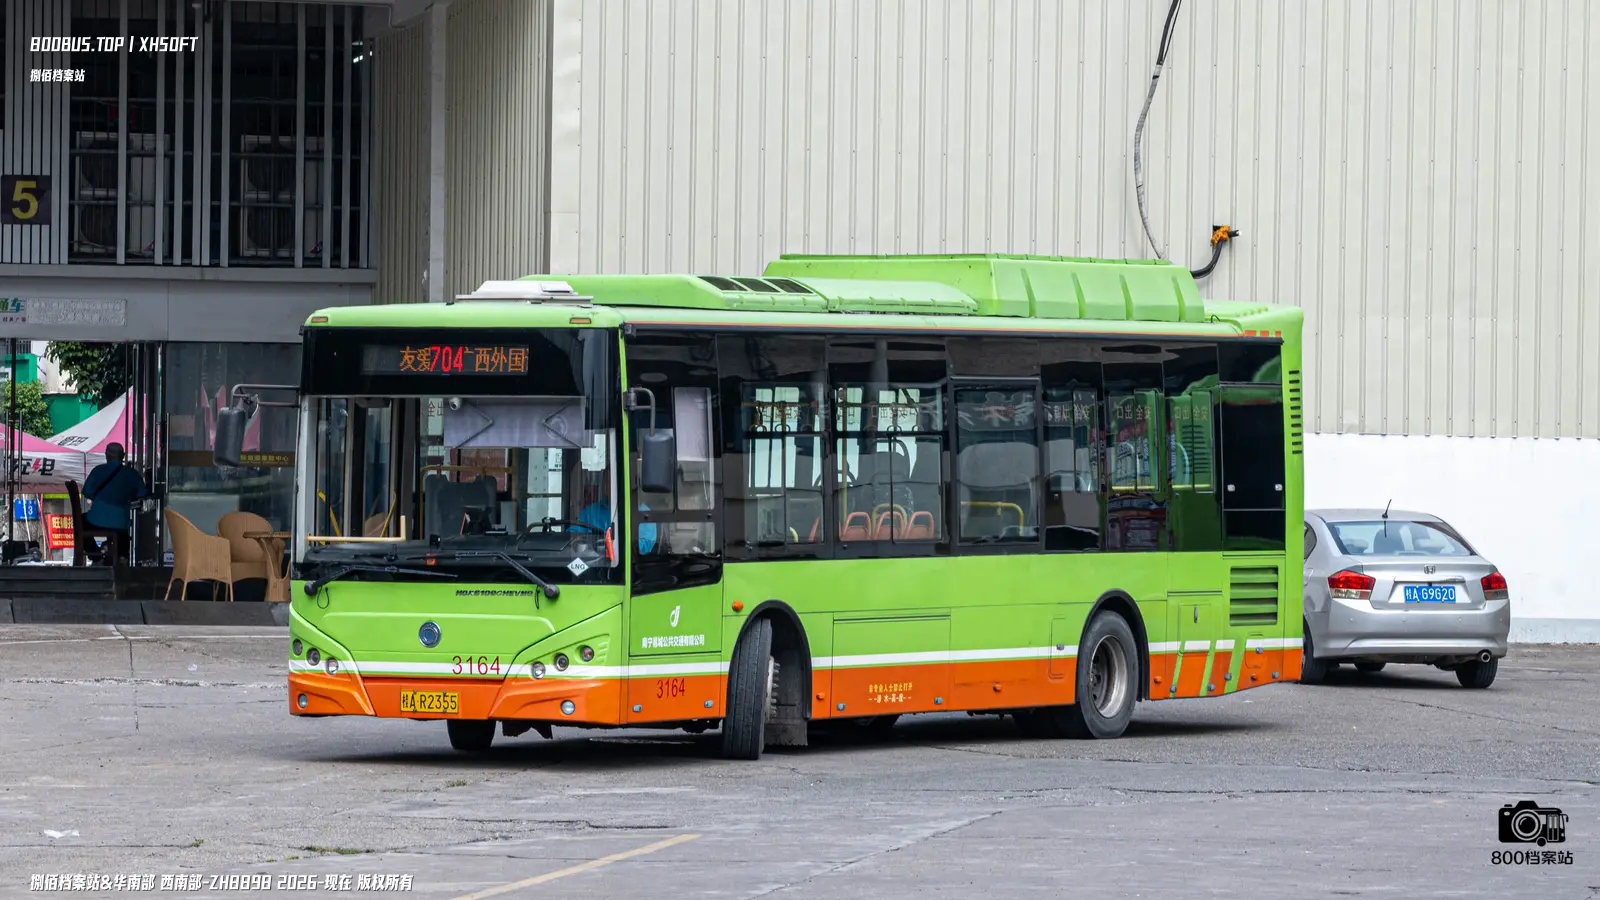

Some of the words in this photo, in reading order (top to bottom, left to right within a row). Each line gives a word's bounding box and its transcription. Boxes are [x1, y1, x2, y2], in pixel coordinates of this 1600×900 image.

[12, 180, 38, 219] 5
[452, 655, 500, 675] 3164
[656, 677, 686, 699] 3164
